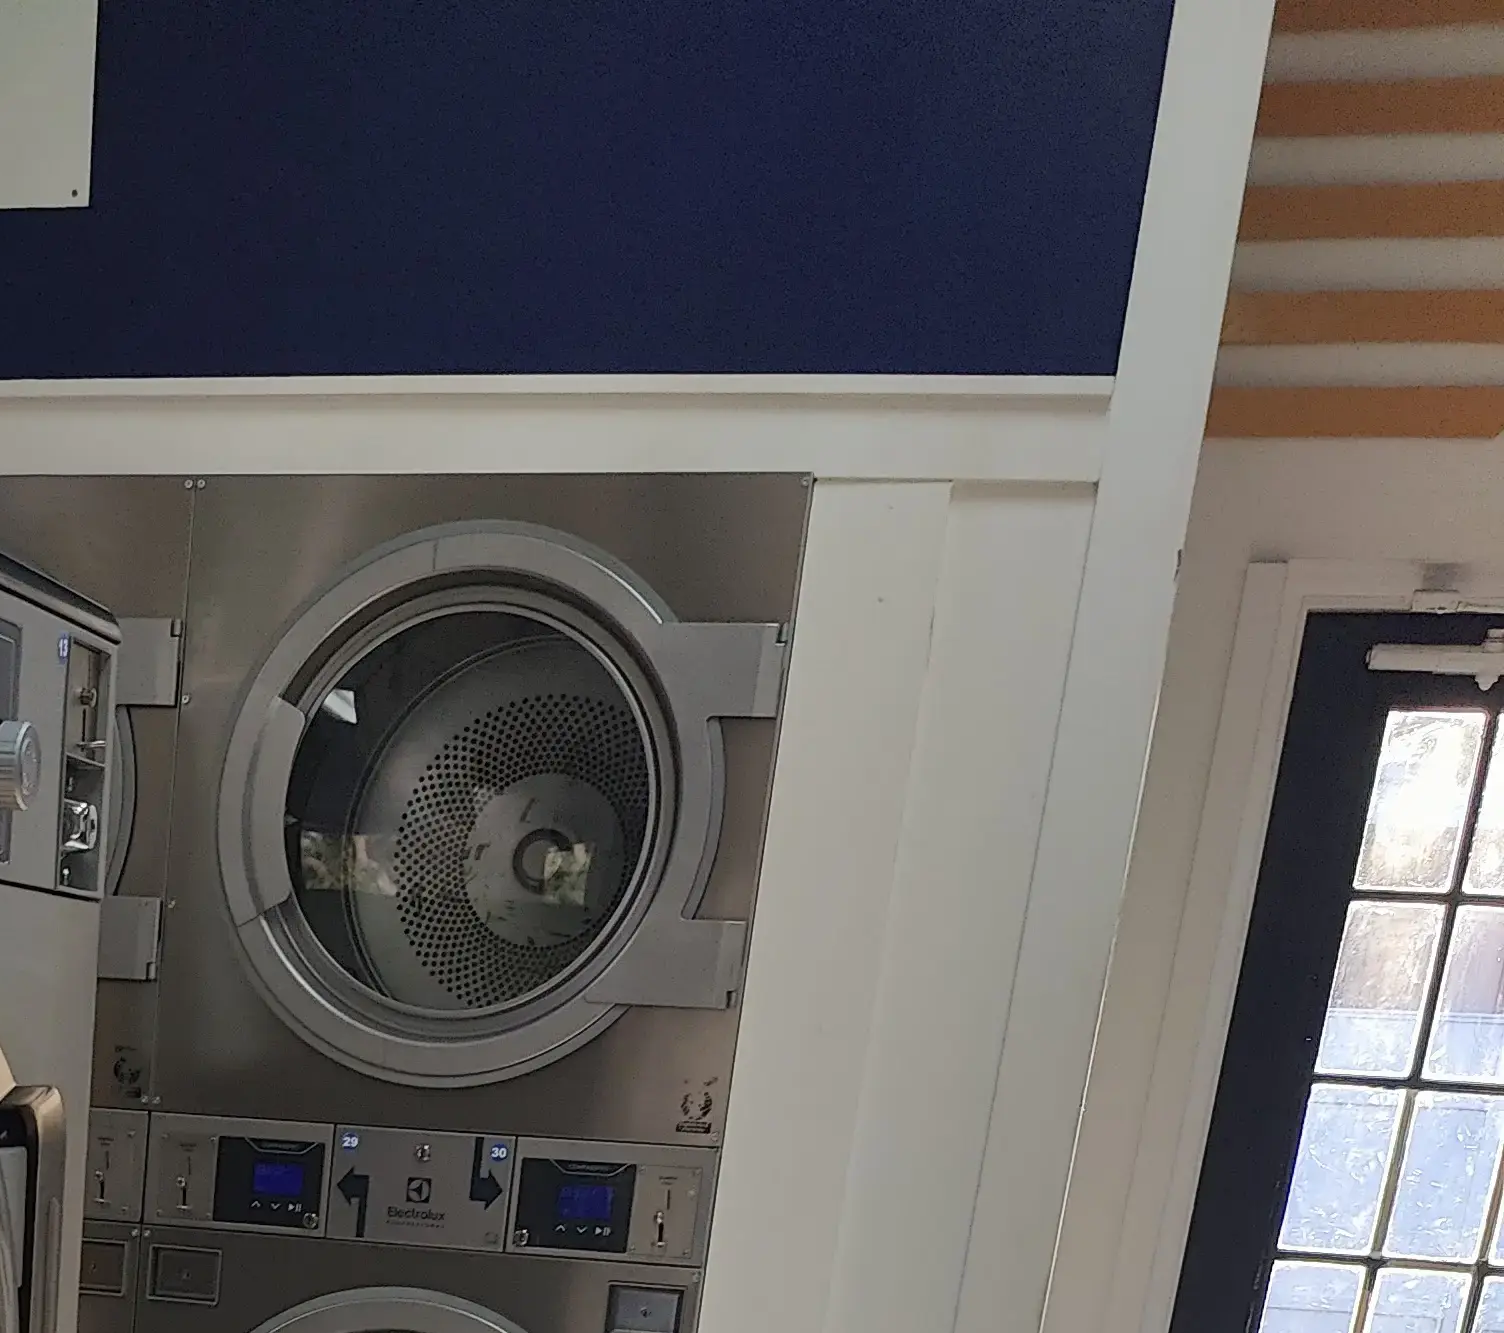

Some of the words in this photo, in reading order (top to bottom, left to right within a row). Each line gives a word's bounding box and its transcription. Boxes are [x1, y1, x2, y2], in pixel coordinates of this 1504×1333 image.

[58, 638, 69, 657] 13
[342, 1136, 359, 1147] 29
[491, 1147, 507, 1158] 30
[387, 1206, 445, 1221] Electrolux
